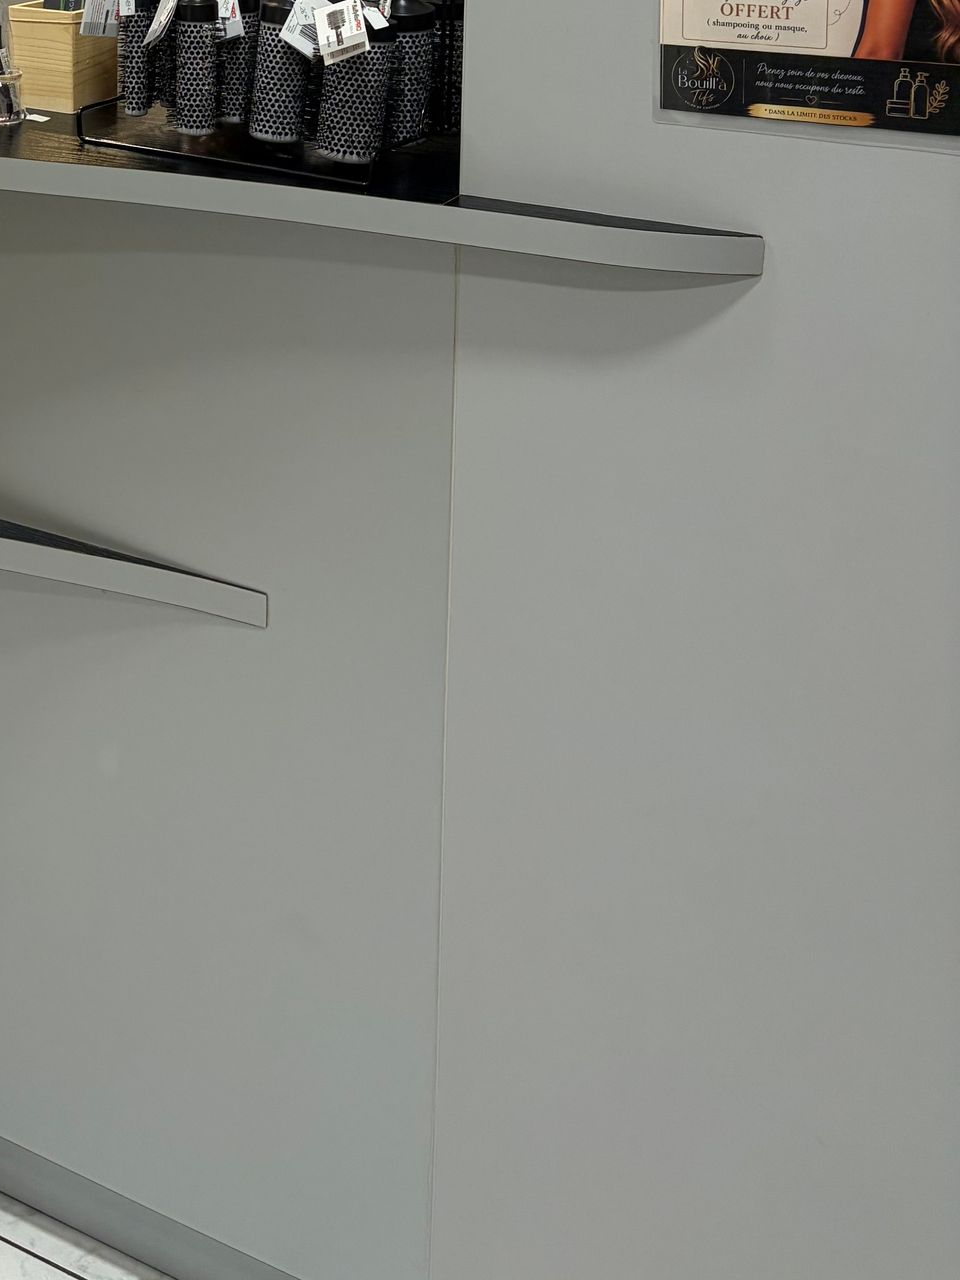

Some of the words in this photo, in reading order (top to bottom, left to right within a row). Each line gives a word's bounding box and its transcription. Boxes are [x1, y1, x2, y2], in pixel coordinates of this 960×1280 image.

[720, 2, 794, 20] OFFERT
[757, 62, 786, 79] Prenez
[805, 68, 815, 77] de
[795, 83, 830, 94] occupons
[831, 83, 843, 93] du
[690, 89, 714, 105] Tifs
